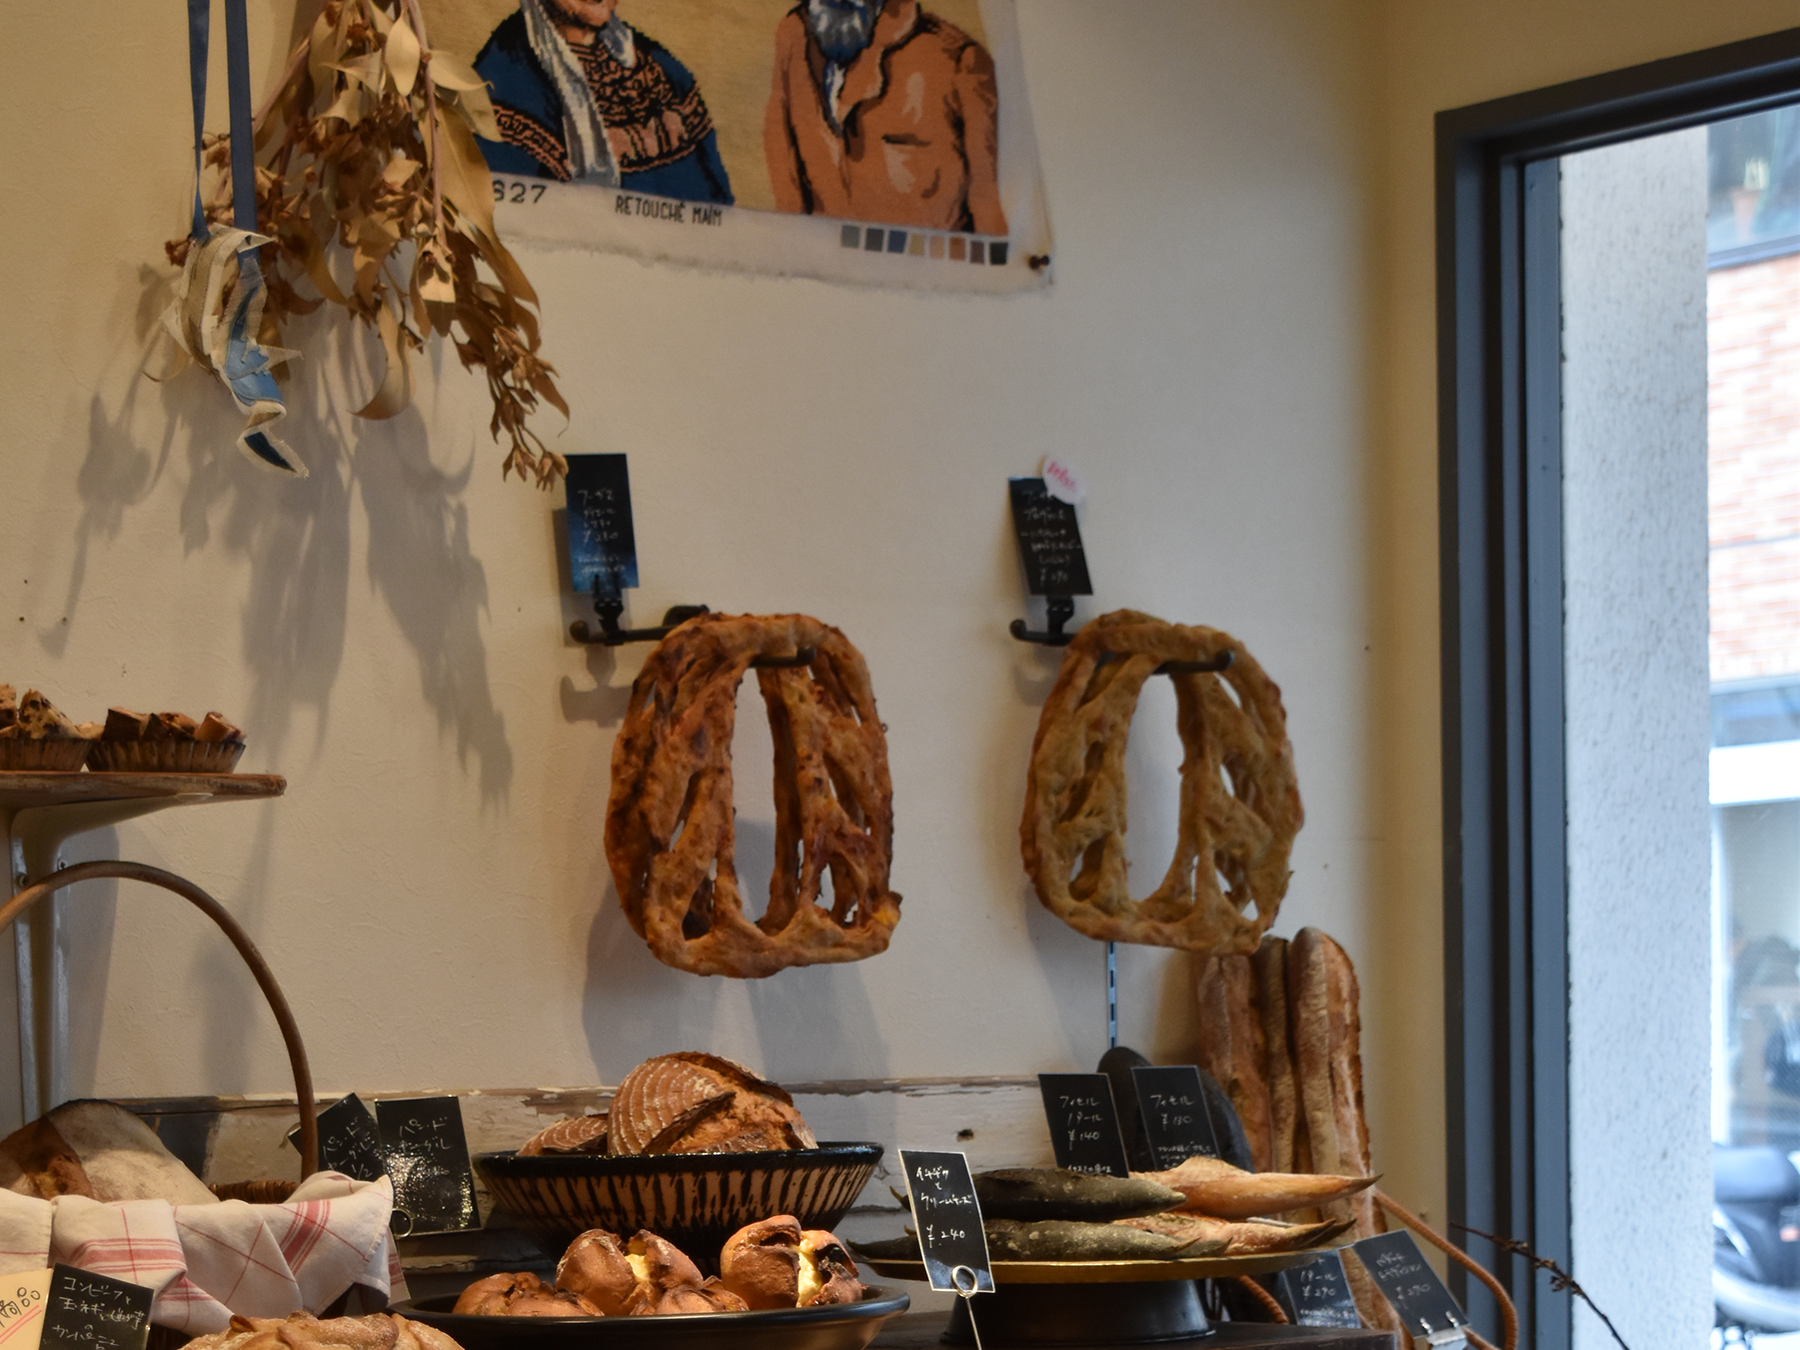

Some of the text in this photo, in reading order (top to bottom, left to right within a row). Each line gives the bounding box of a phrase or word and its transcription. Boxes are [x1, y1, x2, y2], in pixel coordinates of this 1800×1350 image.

[615, 194, 686, 223] RETOUCHÉ
[351, 1163, 373, 1181] 1/2
[921, 1192, 973, 1211] クリームチーズ
[925, 1224, 965, 1249] ¥240
